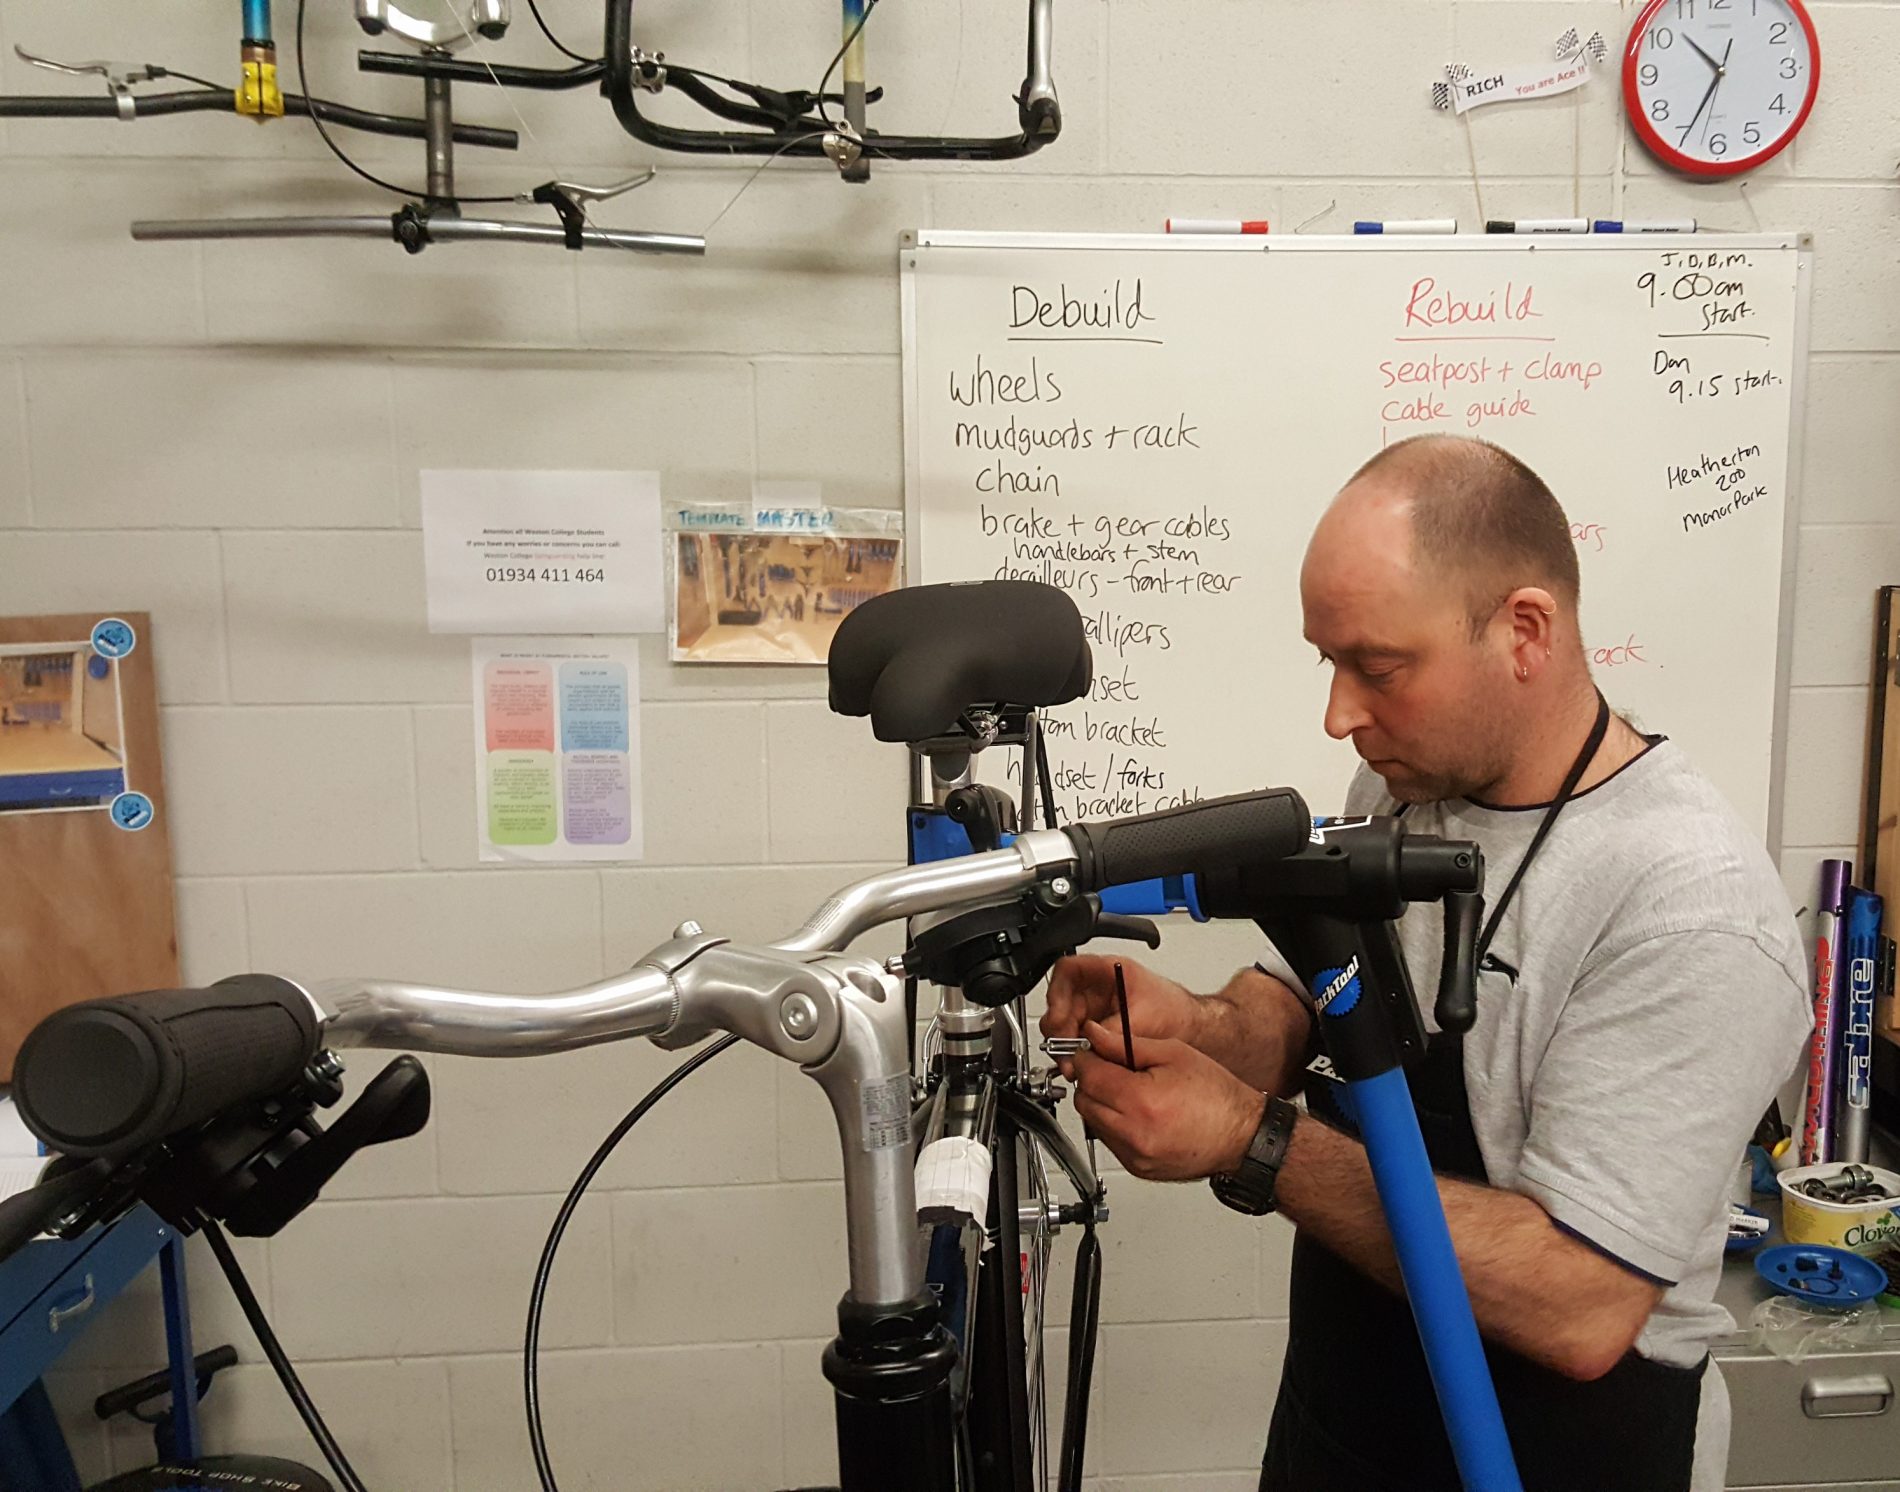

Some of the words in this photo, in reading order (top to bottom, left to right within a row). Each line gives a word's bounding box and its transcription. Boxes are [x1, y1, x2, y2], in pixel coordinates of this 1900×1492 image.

[1649, 27, 1673, 50] 10
[1769, 22, 1787, 44] 2
[1640, 64, 1658, 86] 9
[1779, 57, 1797, 79] 3
[1466, 75, 1505, 98] RICH
[1515, 84, 1535, 96] You
[1538, 77, 1555, 88] are
[1557, 70, 1576, 83] Ace
[1651, 99, 1669, 121] 8
[1768, 93, 1786, 115] 4
[1709, 133, 1727, 155] 6
[1743, 121, 1760, 144] 5
[1008, 278, 1156, 329] Debuild
[1405, 277, 1543, 327] Rebuild
[1379, 353, 1491, 390] seatpost
[1524, 352, 1602, 390] clamp
[1654, 350, 1690, 375] Dan
[950, 354, 1062, 406] wheels
[1669, 374, 1723, 404] 9.15
[1467, 389, 1536, 427] guide
[1134, 412, 1200, 448] rack
[976, 459, 1060, 496] chain
[1667, 445, 1760, 489] Heatherton
[981, 504, 1061, 538] brake
[1094, 516, 1160, 549] gear
[1164, 505, 1230, 540] cables
[1569, 522, 1607, 552] ars
[1147, 540, 1199, 565] stem
[486, 568, 536, 582] 01934
[541, 568, 570, 582] 411
[575, 568, 605, 583] 464
[1085, 711, 1166, 747] bracket
[1844, 958, 1874, 1108] sabre
